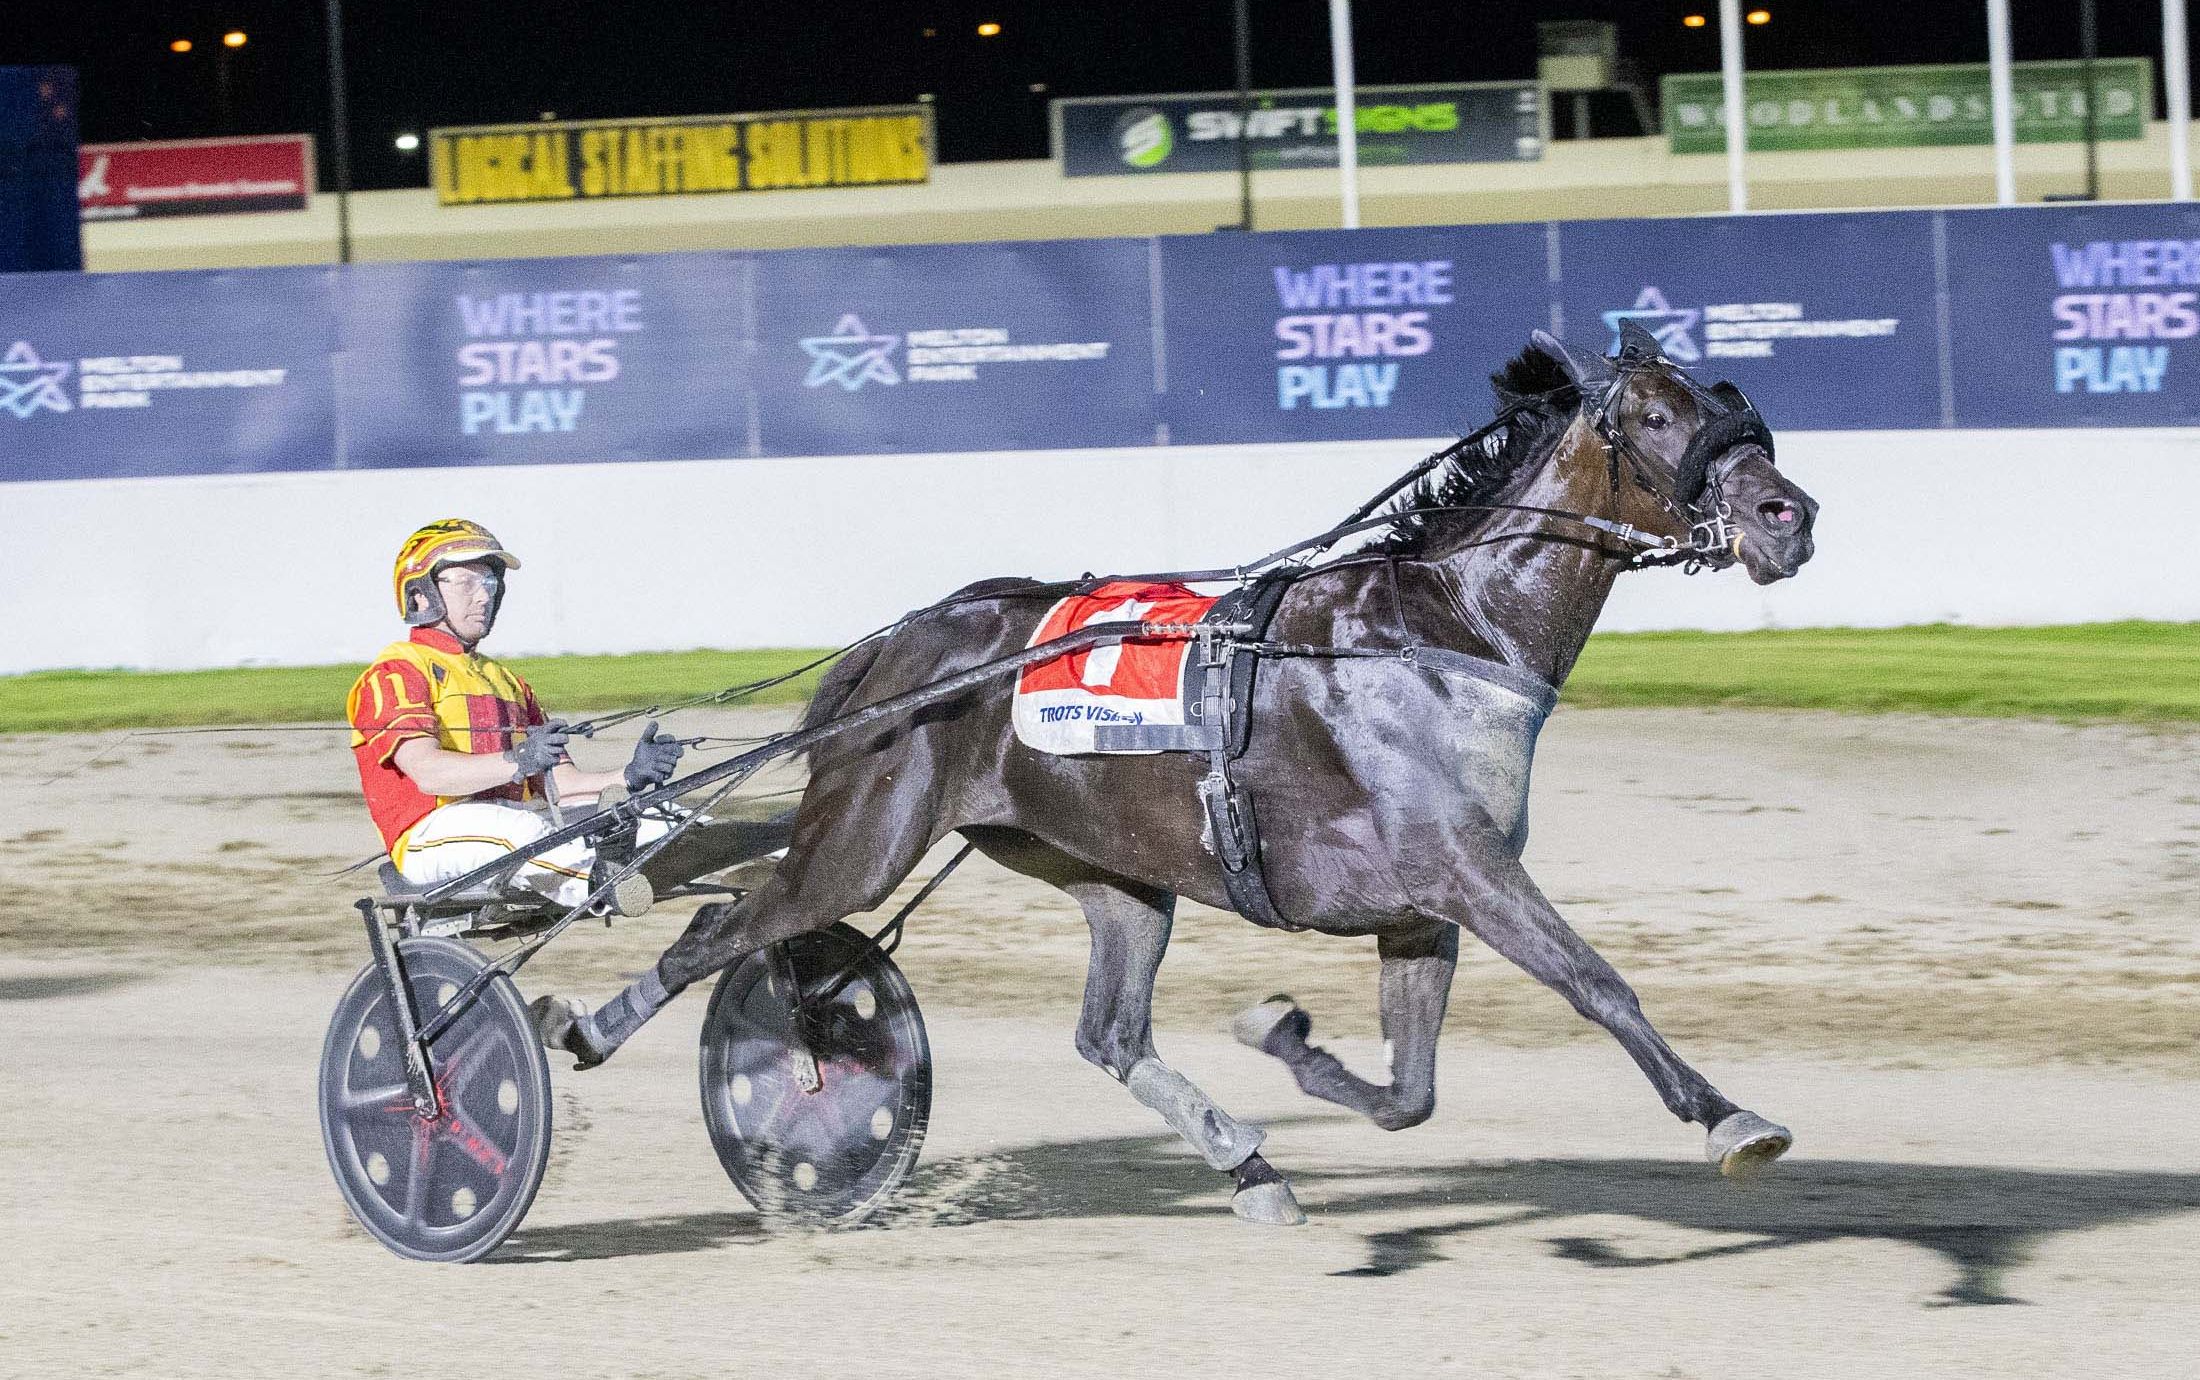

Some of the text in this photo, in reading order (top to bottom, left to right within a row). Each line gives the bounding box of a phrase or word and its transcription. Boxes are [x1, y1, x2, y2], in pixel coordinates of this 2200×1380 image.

[580, 122, 739, 197] STAFFING
[1273, 260, 1454, 307] WHERE
[2051, 240, 2200, 287] WHER
[455, 288, 643, 335] WHERE
[1275, 311, 1433, 359] STARS
[2052, 292, 2200, 340] STARS
[457, 339, 619, 385] STARS
[2054, 346, 2170, 393] PLAY
[1277, 363, 1400, 410] PLAY
[462, 388, 586, 434] PLAY
[1040, 705, 1084, 722] TROTS
